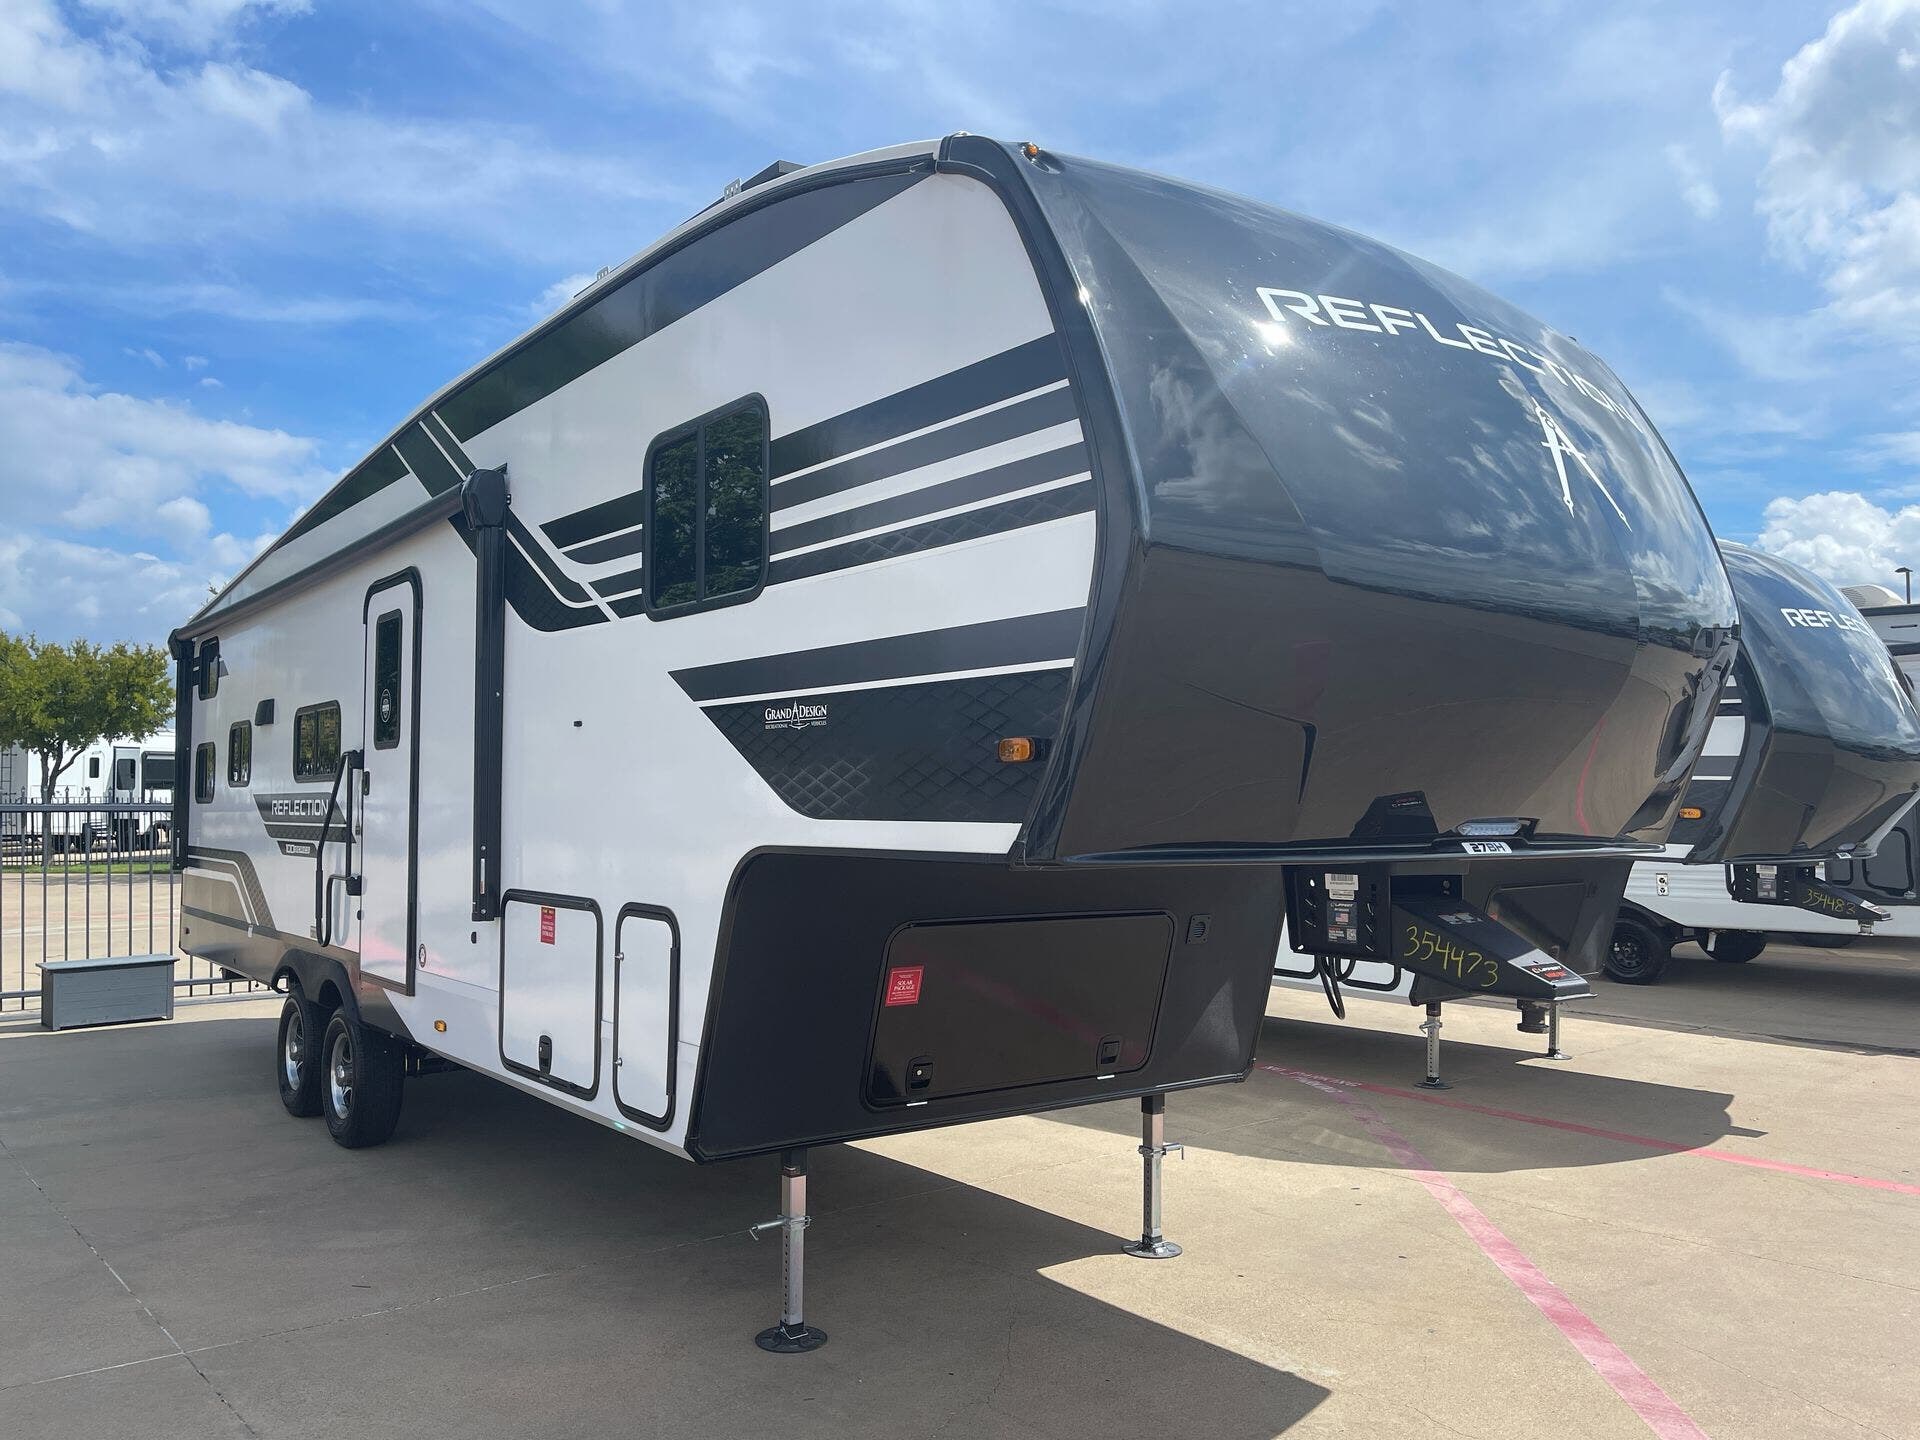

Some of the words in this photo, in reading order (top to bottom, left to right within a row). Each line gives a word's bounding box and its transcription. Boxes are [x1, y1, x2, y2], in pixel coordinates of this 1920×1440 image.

[1255, 286, 1644, 433] REFLECTION
[765, 707, 792, 720] GRAND
[799, 704, 828, 718] DESIGN
[271, 799, 329, 816] REFLECTION
[1470, 842, 1506, 853] 27BH
[1403, 925, 1499, 988] 354473
